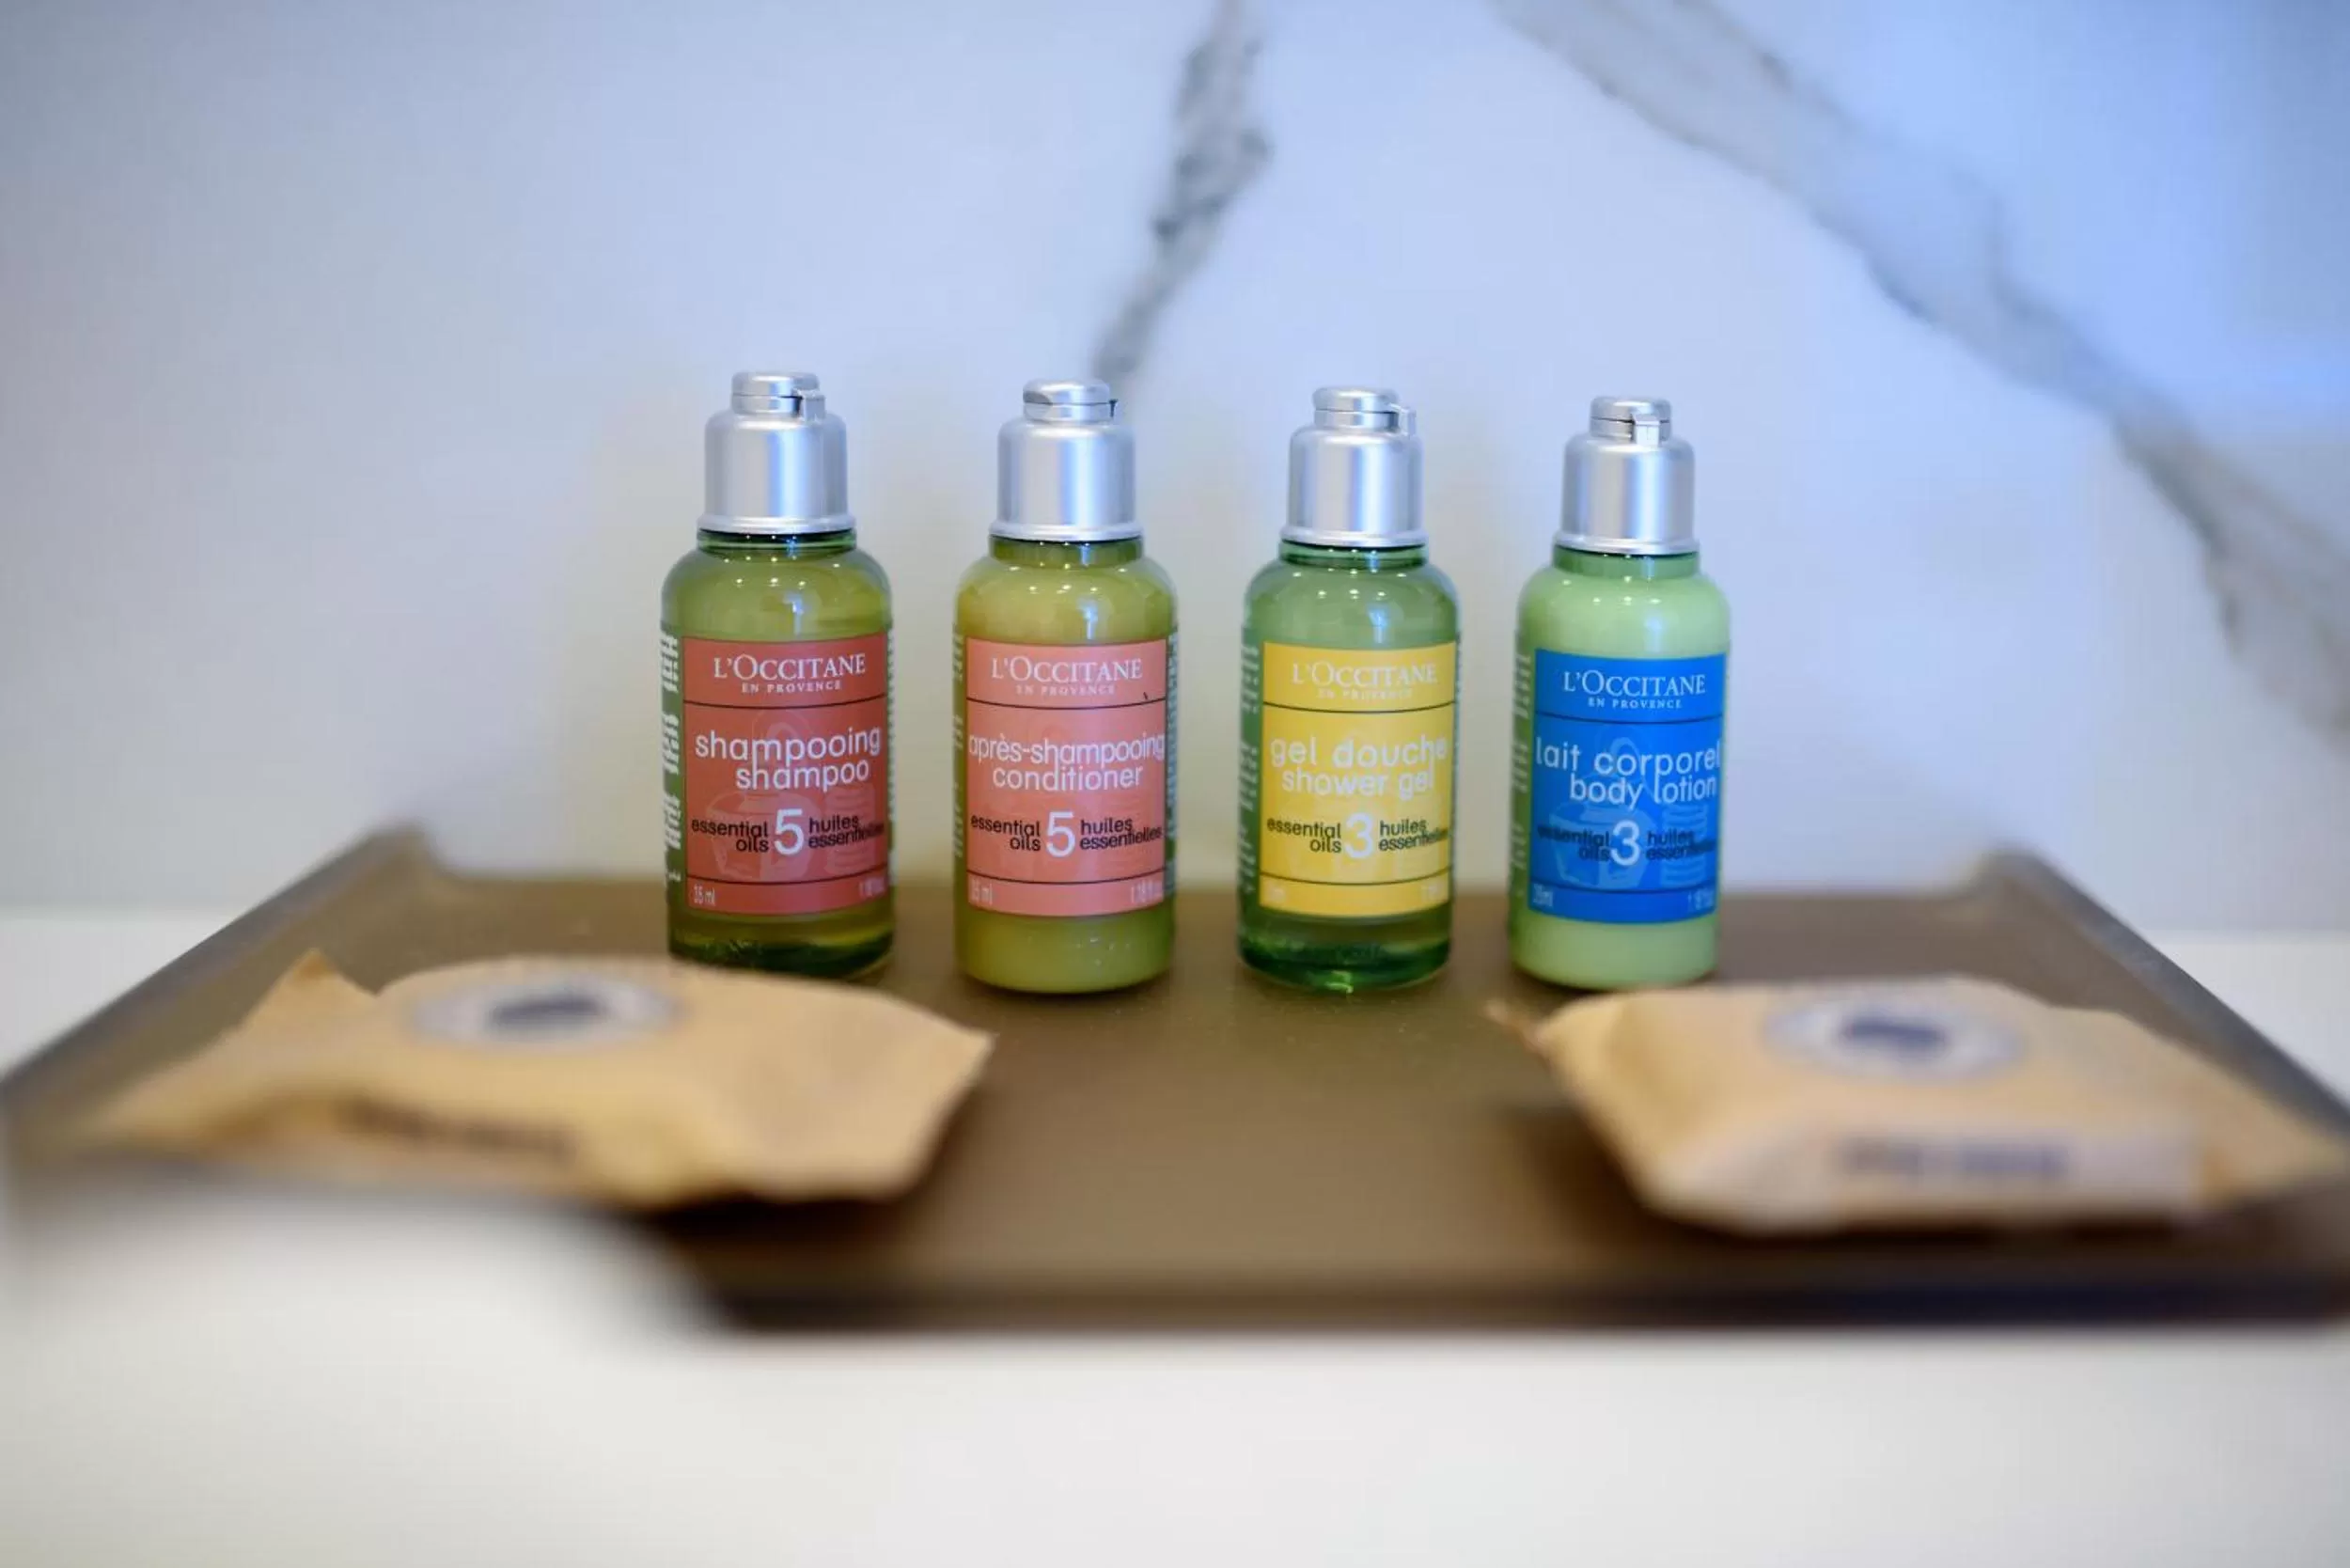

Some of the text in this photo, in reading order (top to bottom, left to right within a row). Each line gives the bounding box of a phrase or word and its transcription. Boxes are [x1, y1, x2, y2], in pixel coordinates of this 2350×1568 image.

[713, 653, 866, 681] L'OCCITANE
[992, 655, 1142, 682] L'OCCITANE
[1292, 661, 1437, 686] L'OCCITANE
[1563, 669, 1706, 697] L'OCCITANE
[742, 680, 842, 694] EN PROVENCE
[1015, 683, 1116, 697] EN PROVENCE
[1588, 698, 1683, 709] EN PROVENCE
[695, 727, 882, 767] shampooing
[968, 731, 1165, 769] après-shampooing
[1270, 733, 1449, 769] gel douche
[1535, 736, 1721, 780] lait corporel
[736, 758, 870, 792] shampoo
[993, 762, 1143, 792] conditioner
[1281, 760, 1434, 801] shower gel
[1570, 773, 1717, 811] body lotion
[691, 808, 859, 855] essential 5 huiles
[736, 822, 885, 853] oils essenti
[971, 811, 1133, 857] essential 5 huiles
[1010, 826, 1162, 852] oils essentielles
[1266, 811, 1427, 858] essential 3 huiles
[1309, 827, 1451, 854] oils essenti
[1610, 820, 1640, 866] 3
